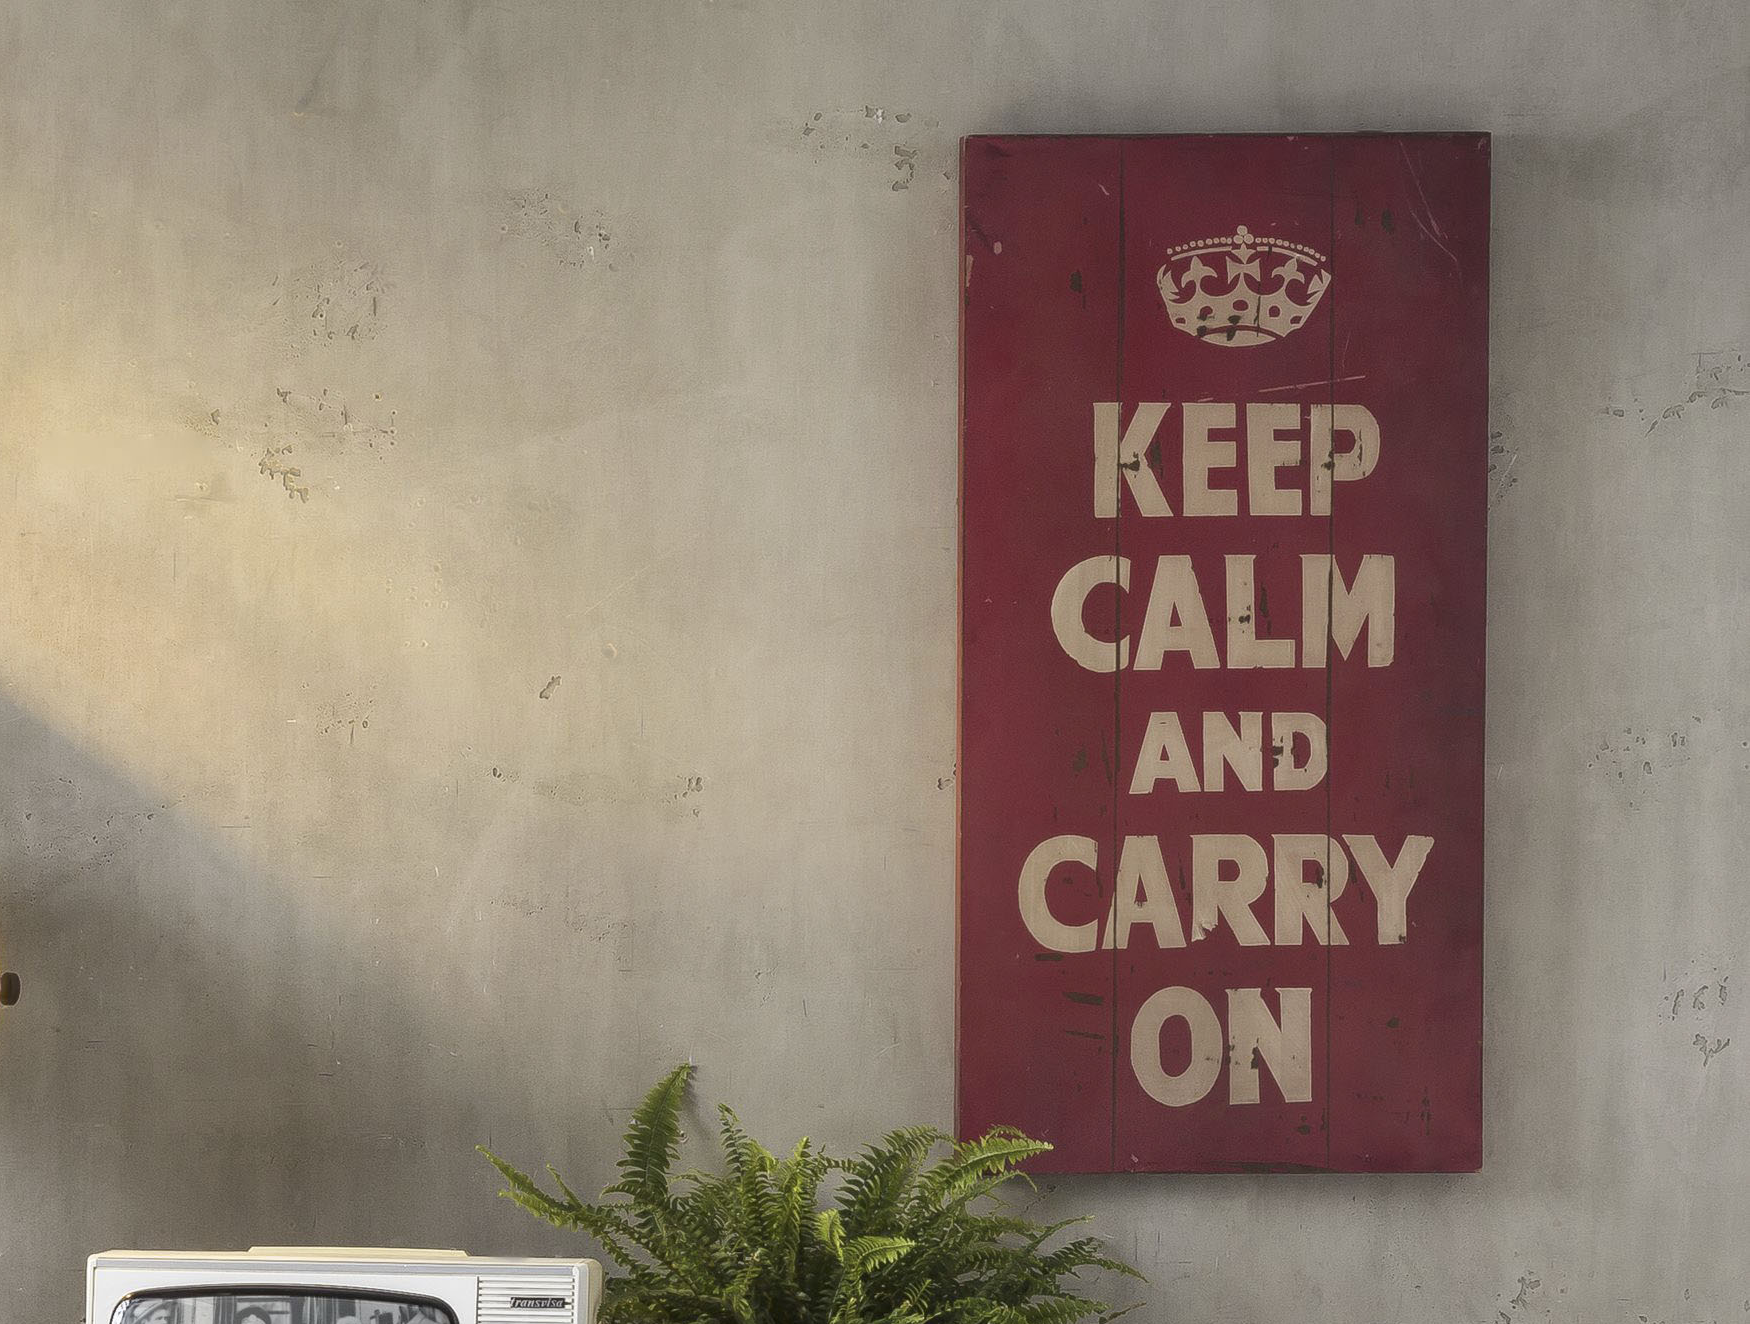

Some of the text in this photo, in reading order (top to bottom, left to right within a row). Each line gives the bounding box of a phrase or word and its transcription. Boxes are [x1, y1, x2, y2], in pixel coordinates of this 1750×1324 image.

[1093, 402, 1380, 518] KEEP
[1050, 554, 1395, 671] CALM
[1130, 711, 1328, 793] AND
[1018, 834, 1433, 952] CARRY
[1130, 986, 1313, 1106] ON
